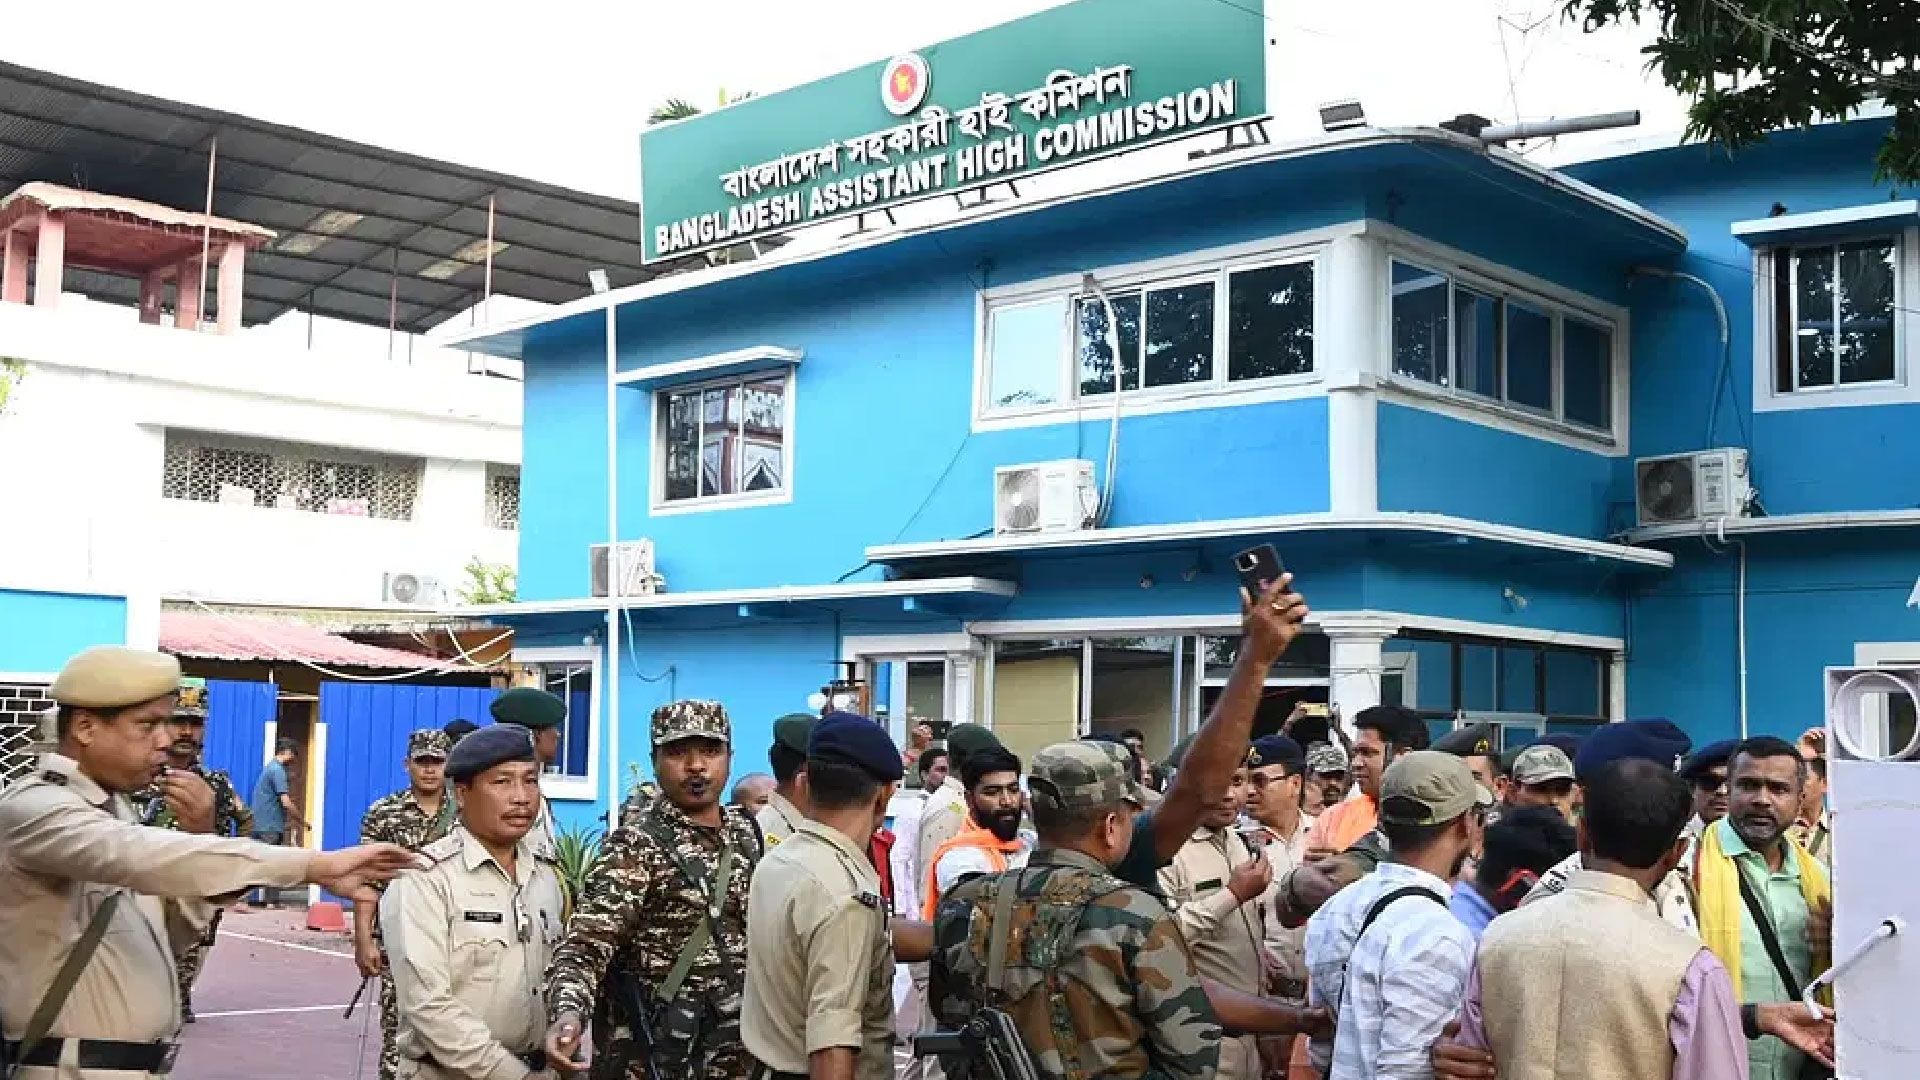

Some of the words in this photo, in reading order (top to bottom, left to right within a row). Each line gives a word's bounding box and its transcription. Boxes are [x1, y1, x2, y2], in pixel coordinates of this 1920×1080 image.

[655, 192, 801, 252] BANGLADESH
[809, 154, 946, 216] ASSISTANT
[958, 133, 1025, 181] HIGH
[1034, 79, 1236, 161] COMMISSION
[719, 138, 843, 199] বাংলাদেশ
[843, 106, 951, 164] সহকারী
[954, 92, 1016, 139] হাই
[1015, 64, 1133, 121] কমিশন
